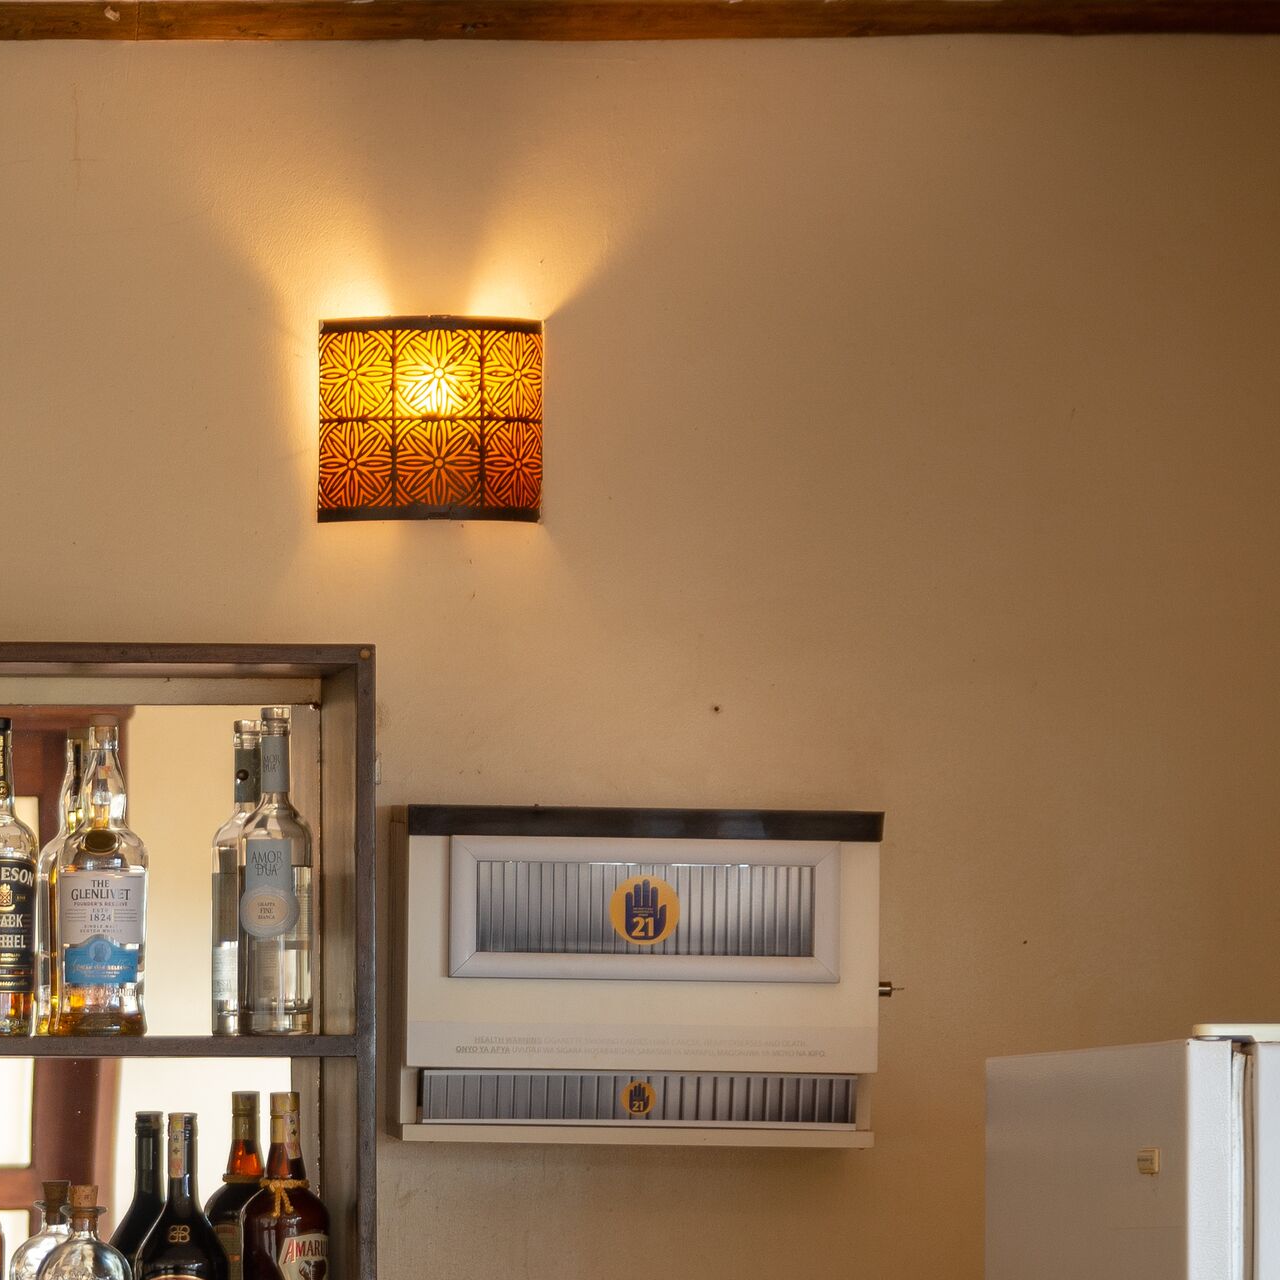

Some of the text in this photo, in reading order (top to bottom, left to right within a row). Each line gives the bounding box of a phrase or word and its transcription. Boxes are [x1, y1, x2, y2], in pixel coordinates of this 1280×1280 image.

[251, 850, 283, 864] AMOR
[91, 880, 109, 888] THE
[71, 888, 131, 901] GLENLIVET
[89, 913, 112, 921] 1824
[631, 916, 655, 937] 21
[631, 1100, 646, 1112] 21
